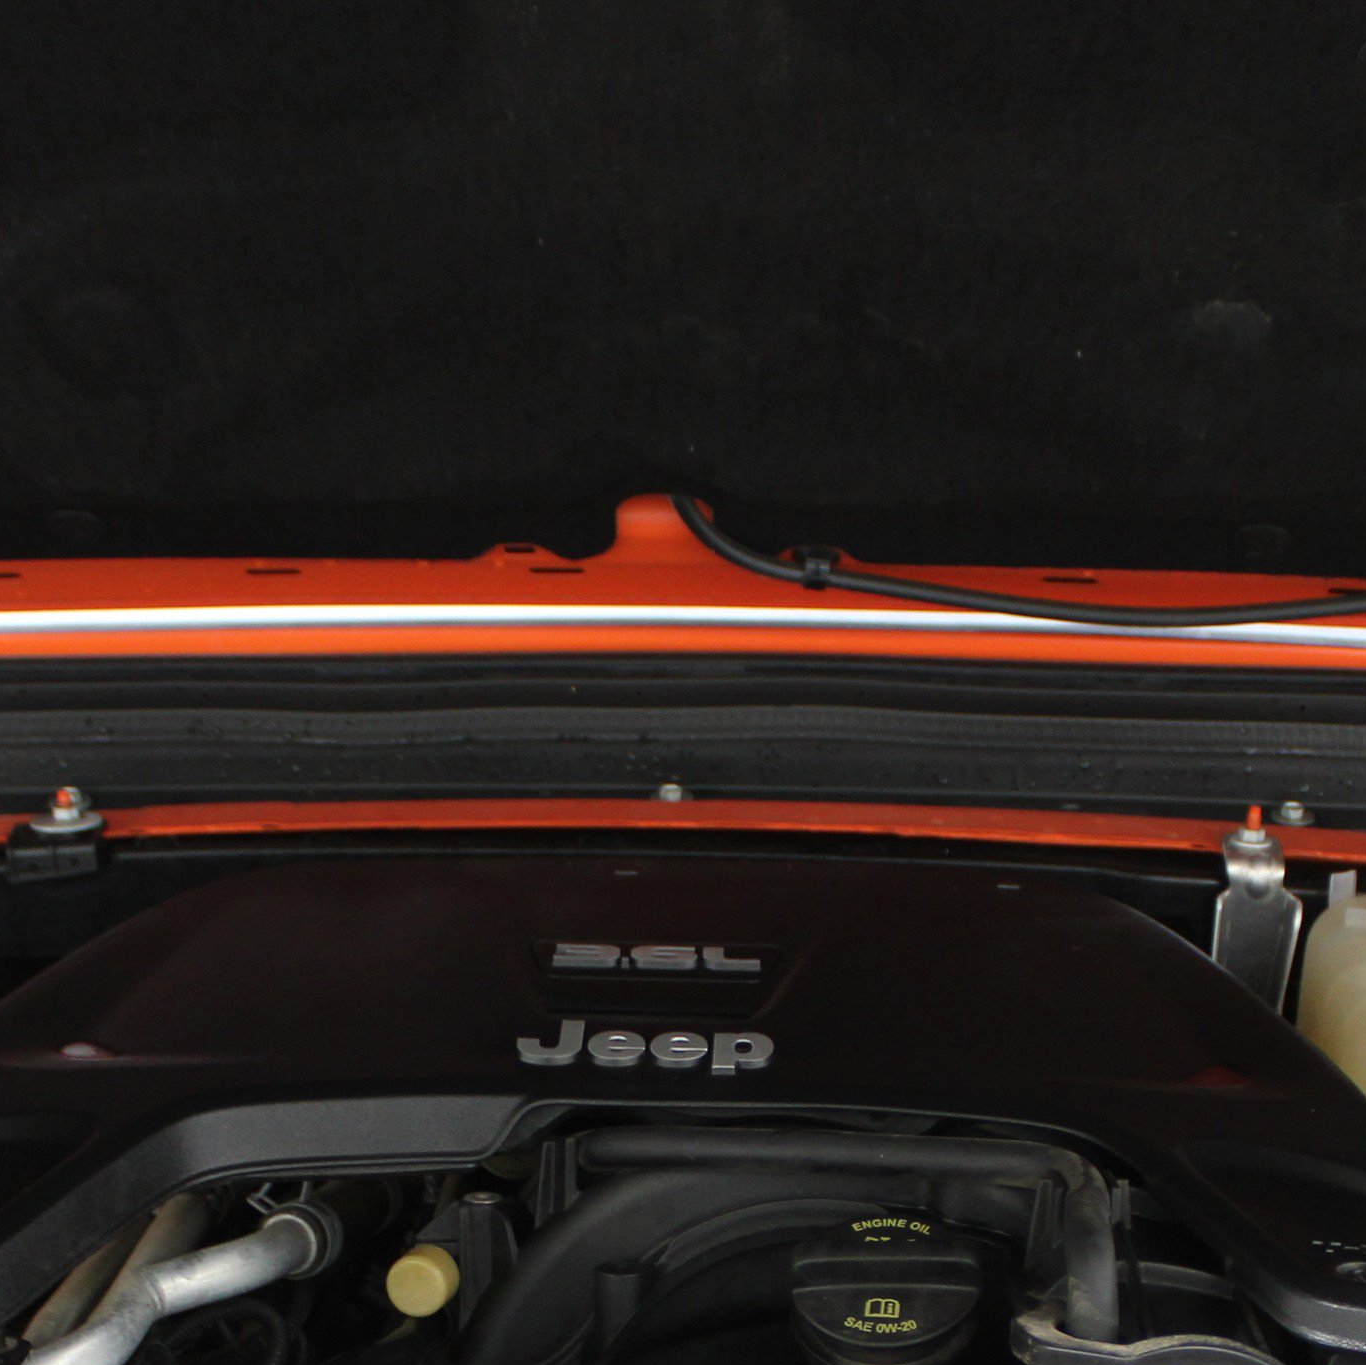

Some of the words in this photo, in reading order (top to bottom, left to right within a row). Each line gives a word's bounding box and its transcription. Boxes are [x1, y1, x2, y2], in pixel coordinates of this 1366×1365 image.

[516, 1018, 774, 1076] Jeep
[852, 1219, 908, 1232] ENGINE
[910, 1222, 931, 1235] OIL
[844, 1317, 874, 1332] SAE
[876, 1319, 917, 1334] 0W-20
